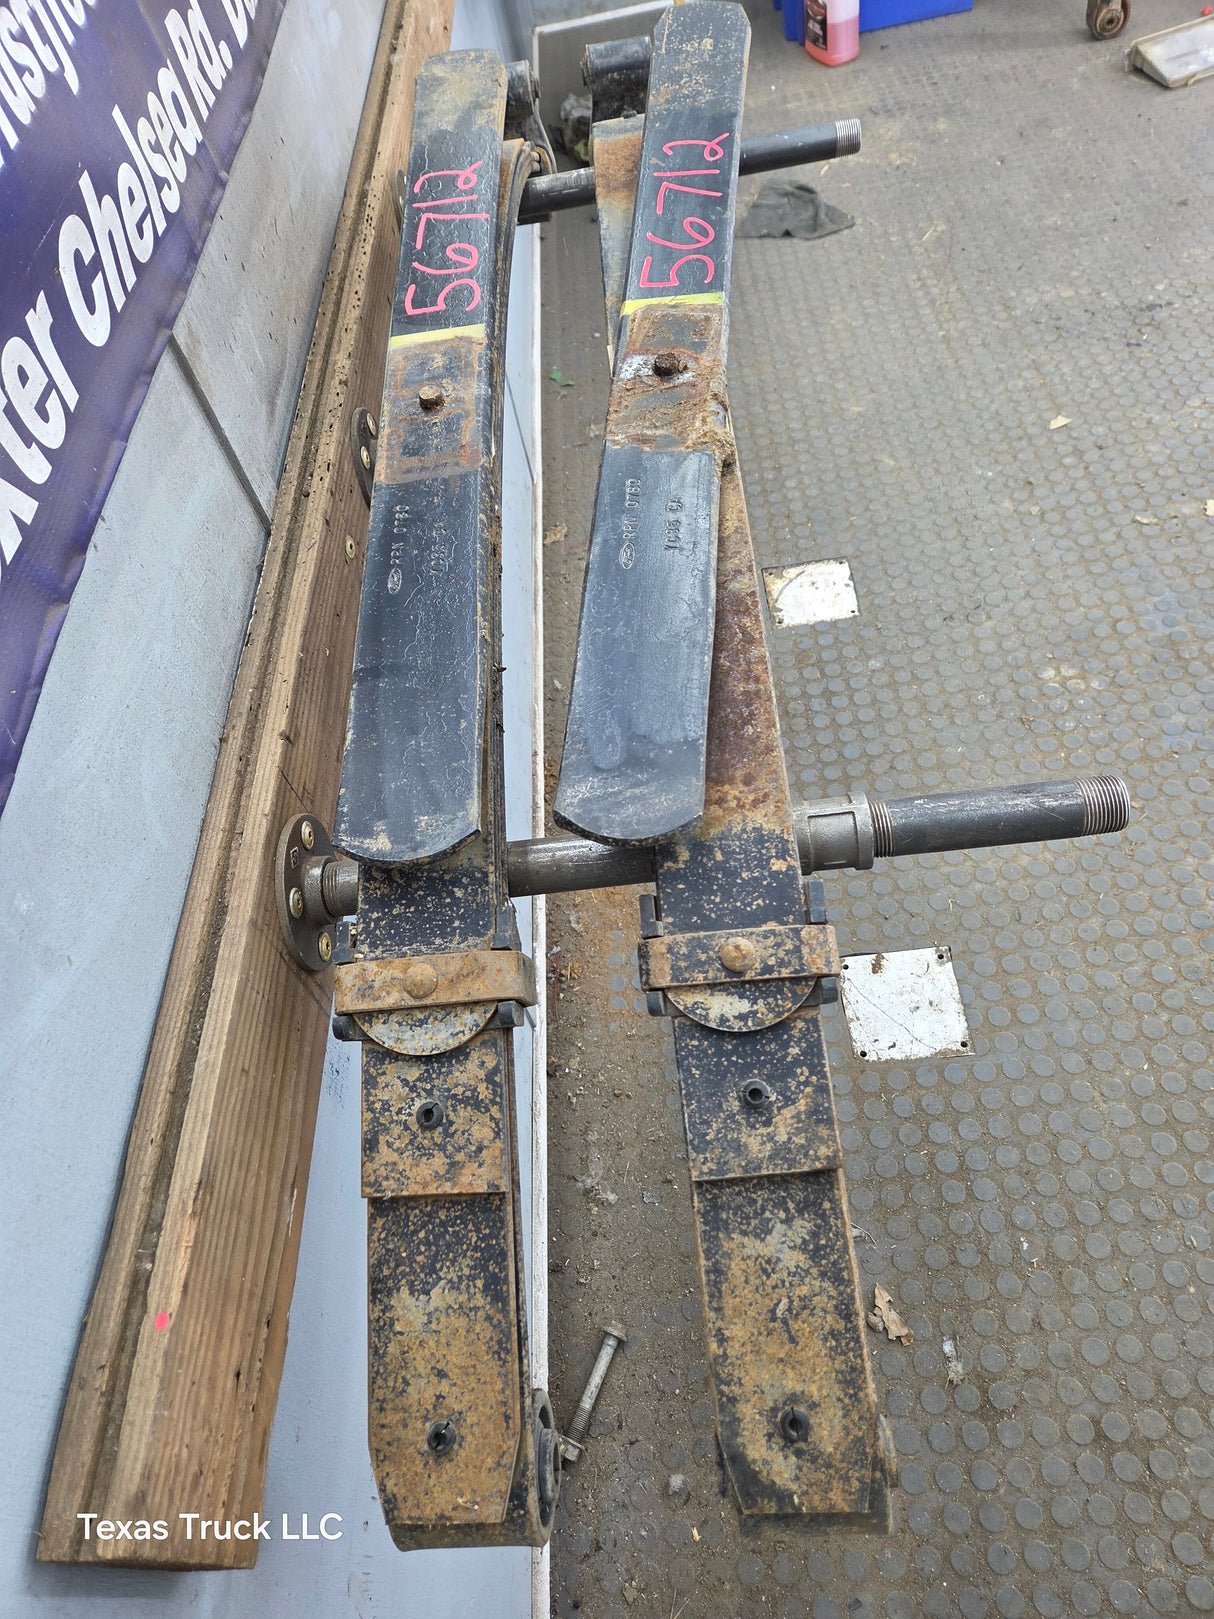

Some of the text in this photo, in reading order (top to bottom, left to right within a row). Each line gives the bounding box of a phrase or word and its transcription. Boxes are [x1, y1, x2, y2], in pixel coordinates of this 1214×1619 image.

[59, 57, 203, 347] Chelsea
[165, 0, 233, 122] Rd.
[404, 161, 490, 315] 56712
[640, 132, 730, 288] 56712
